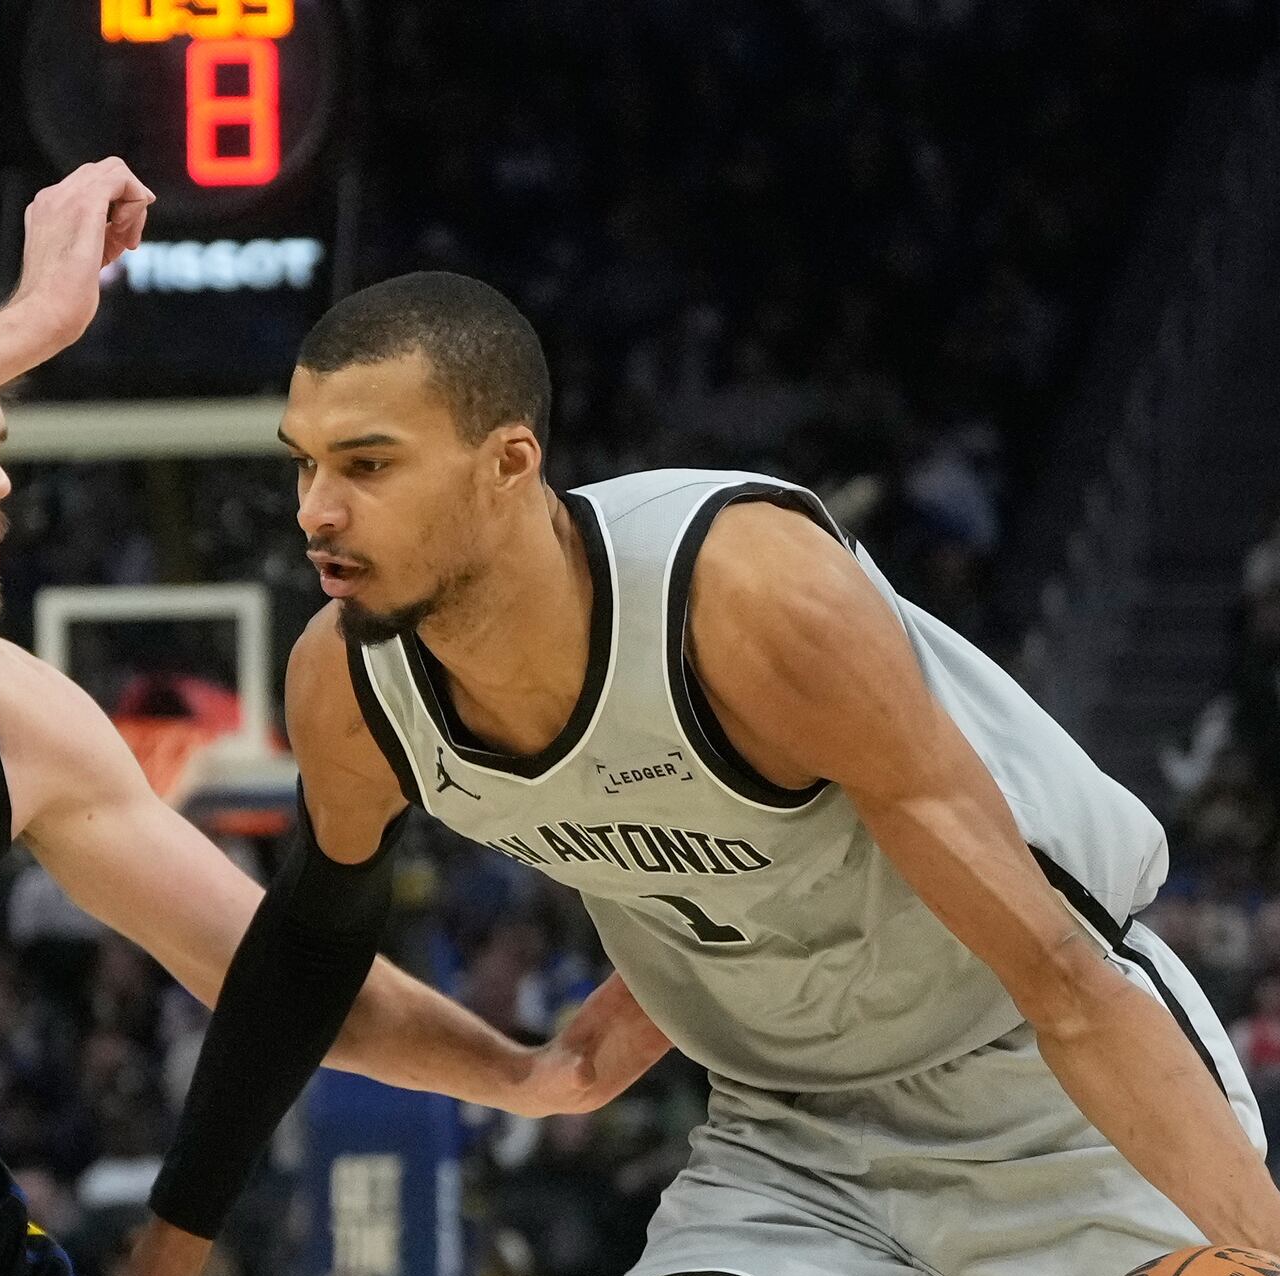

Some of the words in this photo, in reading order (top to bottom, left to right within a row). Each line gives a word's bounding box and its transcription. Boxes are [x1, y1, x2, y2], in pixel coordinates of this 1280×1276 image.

[186, 37, 281, 187] 8
[609, 763, 678, 786] LEDGER
[535, 820, 774, 876] ANTONIO
[637, 894, 752, 945] 1
